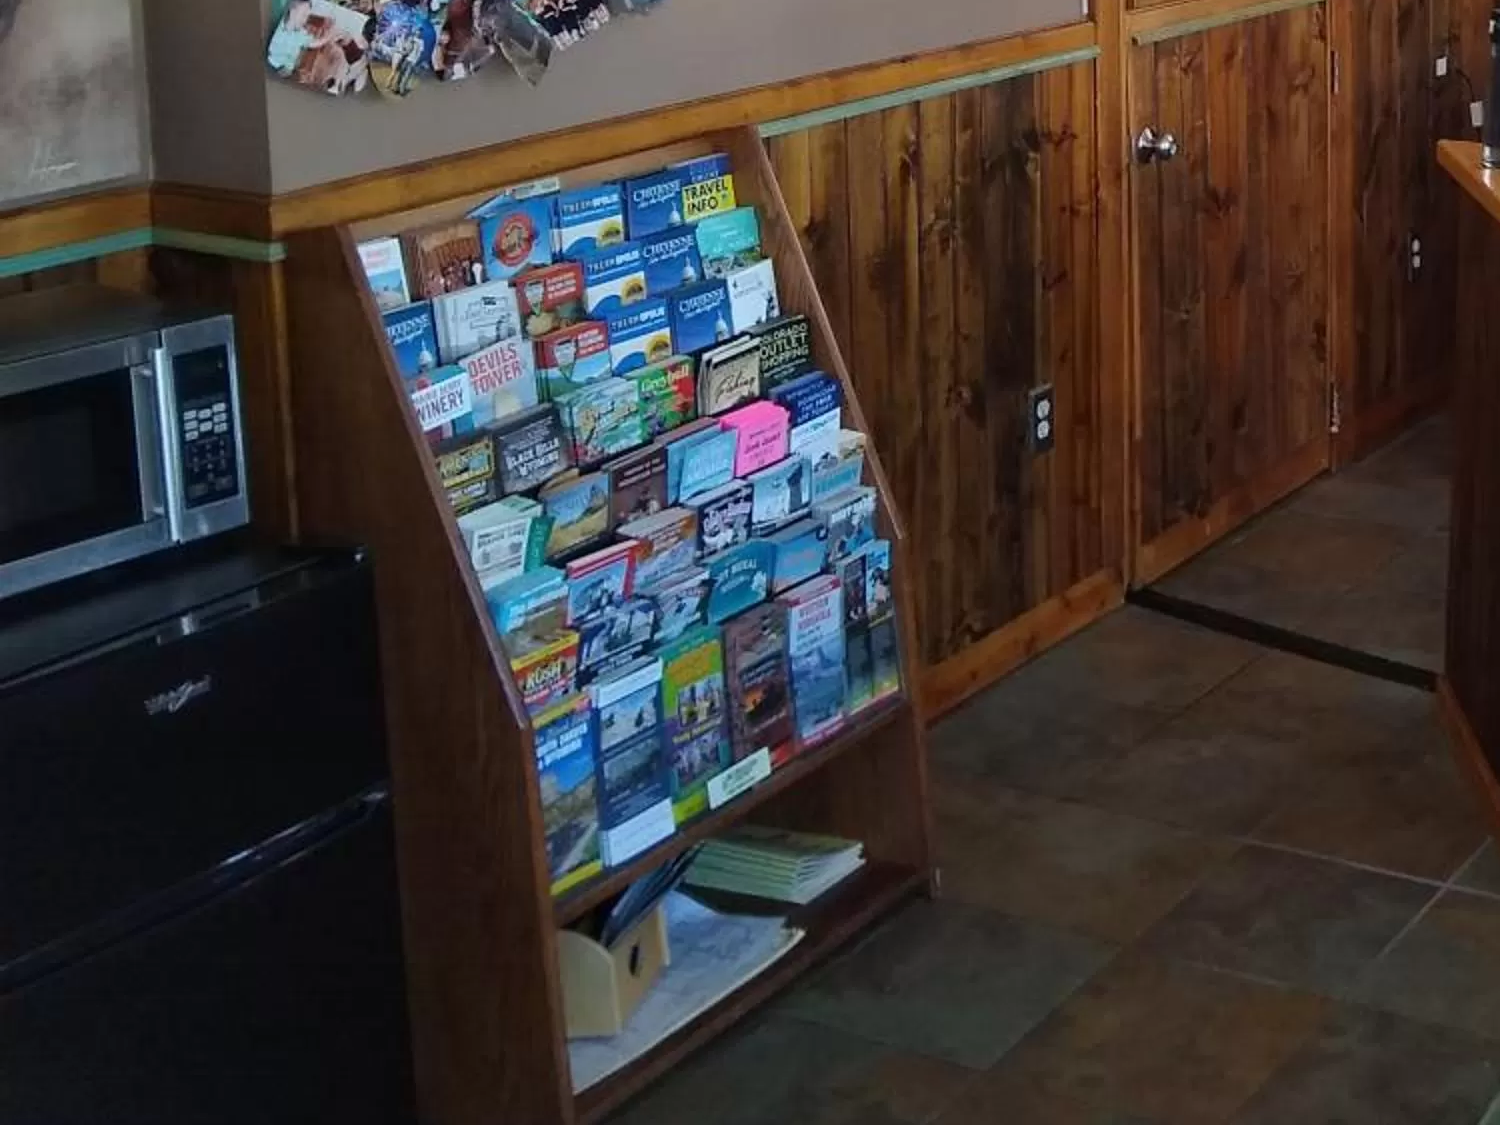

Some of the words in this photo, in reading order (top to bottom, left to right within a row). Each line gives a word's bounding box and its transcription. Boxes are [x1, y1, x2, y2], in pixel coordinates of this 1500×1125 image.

[684, 178, 729, 202] TRAVEL
[687, 195, 719, 216] INFO
[760, 333, 808, 359] OUTLET
[468, 343, 517, 377] DEVILS
